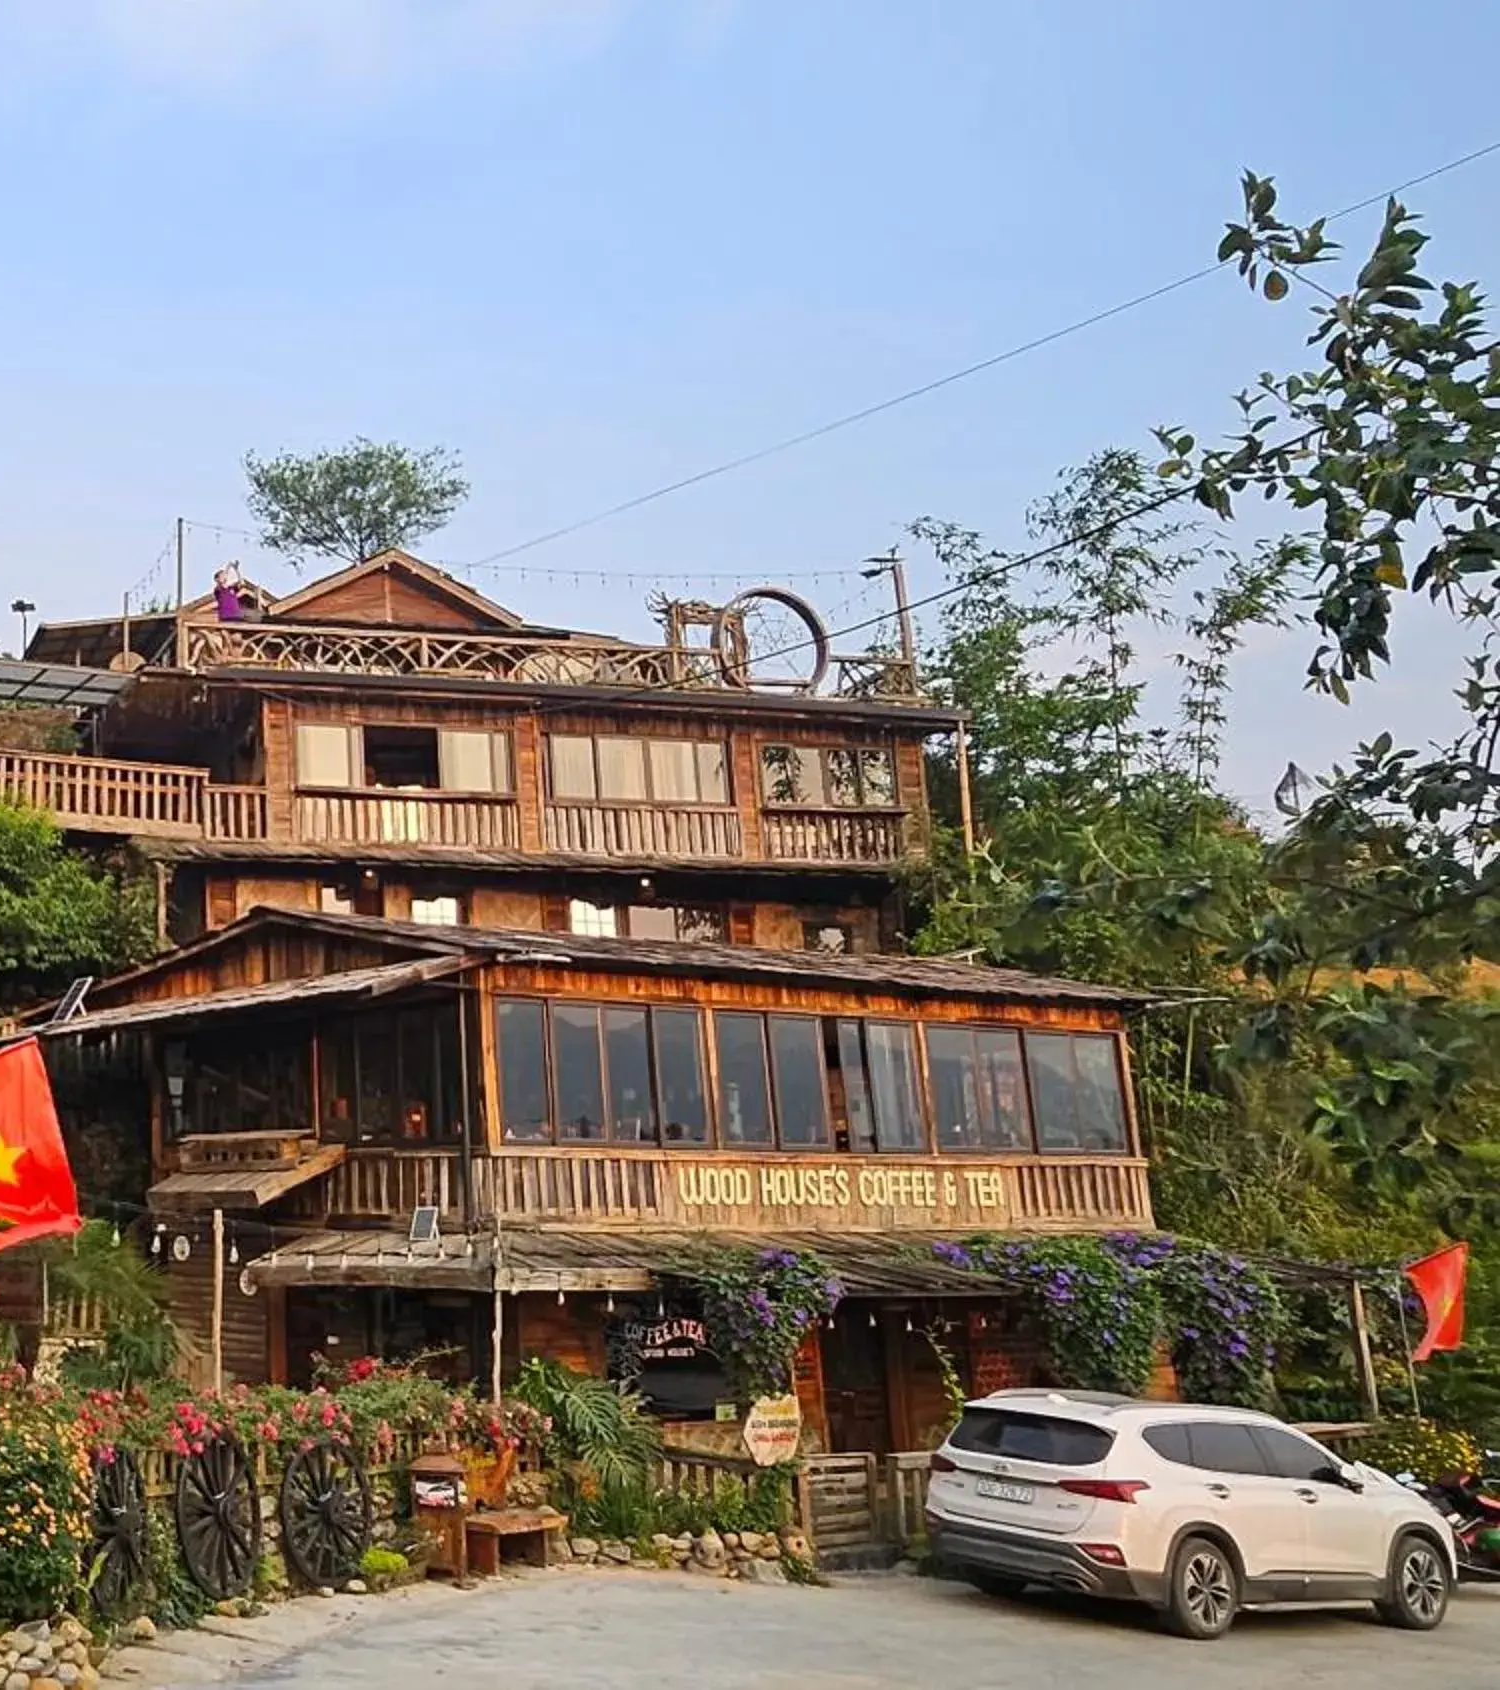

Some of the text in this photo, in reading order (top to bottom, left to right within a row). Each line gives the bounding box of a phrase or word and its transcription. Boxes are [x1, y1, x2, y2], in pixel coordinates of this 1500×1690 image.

[679, 1165, 1004, 1207] WOOD HOUSE'S COFFEE & TEA
